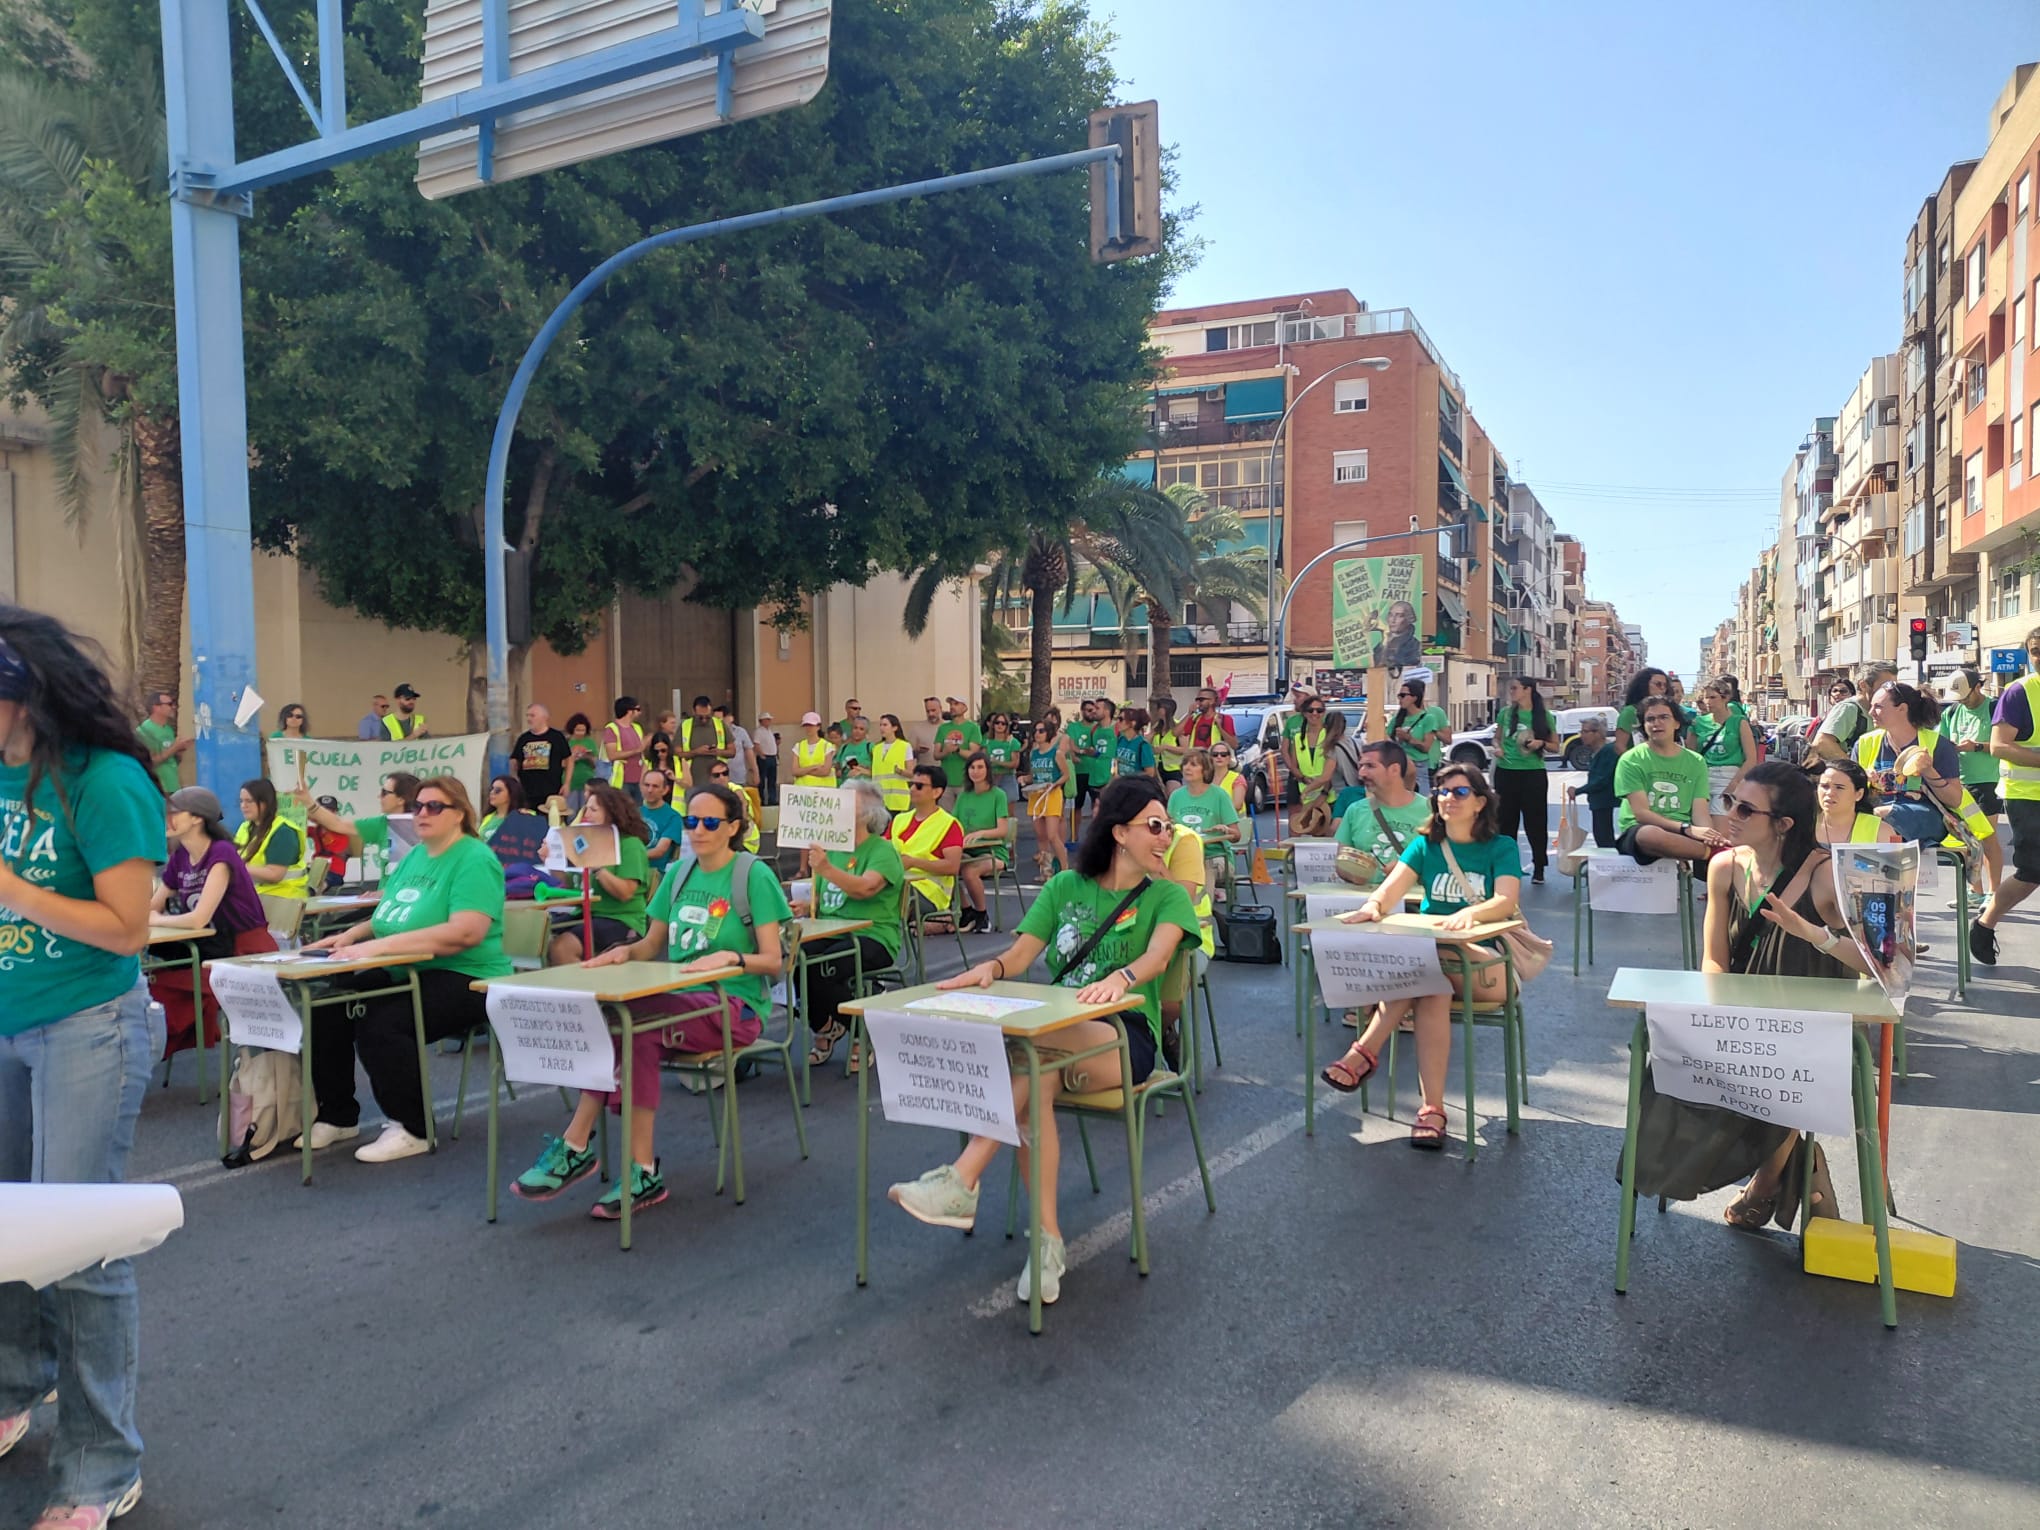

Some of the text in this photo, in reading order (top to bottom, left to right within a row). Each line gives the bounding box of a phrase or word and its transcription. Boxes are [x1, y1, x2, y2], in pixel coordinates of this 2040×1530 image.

[1387, 558, 1416, 568] JORGE
[1387, 567, 1412, 577] JUAN
[1381, 589, 1411, 601] FART!
[2006, 652, 2015, 663] S
[1058, 676, 1107, 689] RASTRO
[284, 742, 466, 766] ECUELA PÚBLICA
[338, 775, 360, 791] DE
[799, 810, 833, 825] VERDA
[1870, 901, 1886, 912] 09
[1871, 913, 1886, 924] 56
[1325, 950, 1426, 968] NO ENTIENDO EL
[1331, 965, 1373, 979] IDIOMA
[1376, 970, 1385, 980] Y
[1345, 982, 1363, 993] ME
[500, 999, 556, 1013] NECESITO
[510, 1016, 585, 1034] TIEMPO PARA
[1690, 1013, 1805, 1035] LLEVO TRES
[518, 1036, 590, 1052] REALIZAR LA
[900, 1032, 939, 1048] SOMOS
[959, 1040, 977, 1055] EN
[1716, 1039, 1777, 1057] MESES
[539, 1057, 575, 1072] TAREA
[898, 1051, 989, 1079] CLASE Y NO HAY
[1681, 1055, 1815, 1083] ESPERANDO AL
[909, 1073, 986, 1100] TIEMPO PARA
[1692, 1074, 1804, 1105] MAESTRO DE
[898, 1093, 1000, 1125] RESOLVER DUDAS
[1719, 1094, 1771, 1117] APOYO
